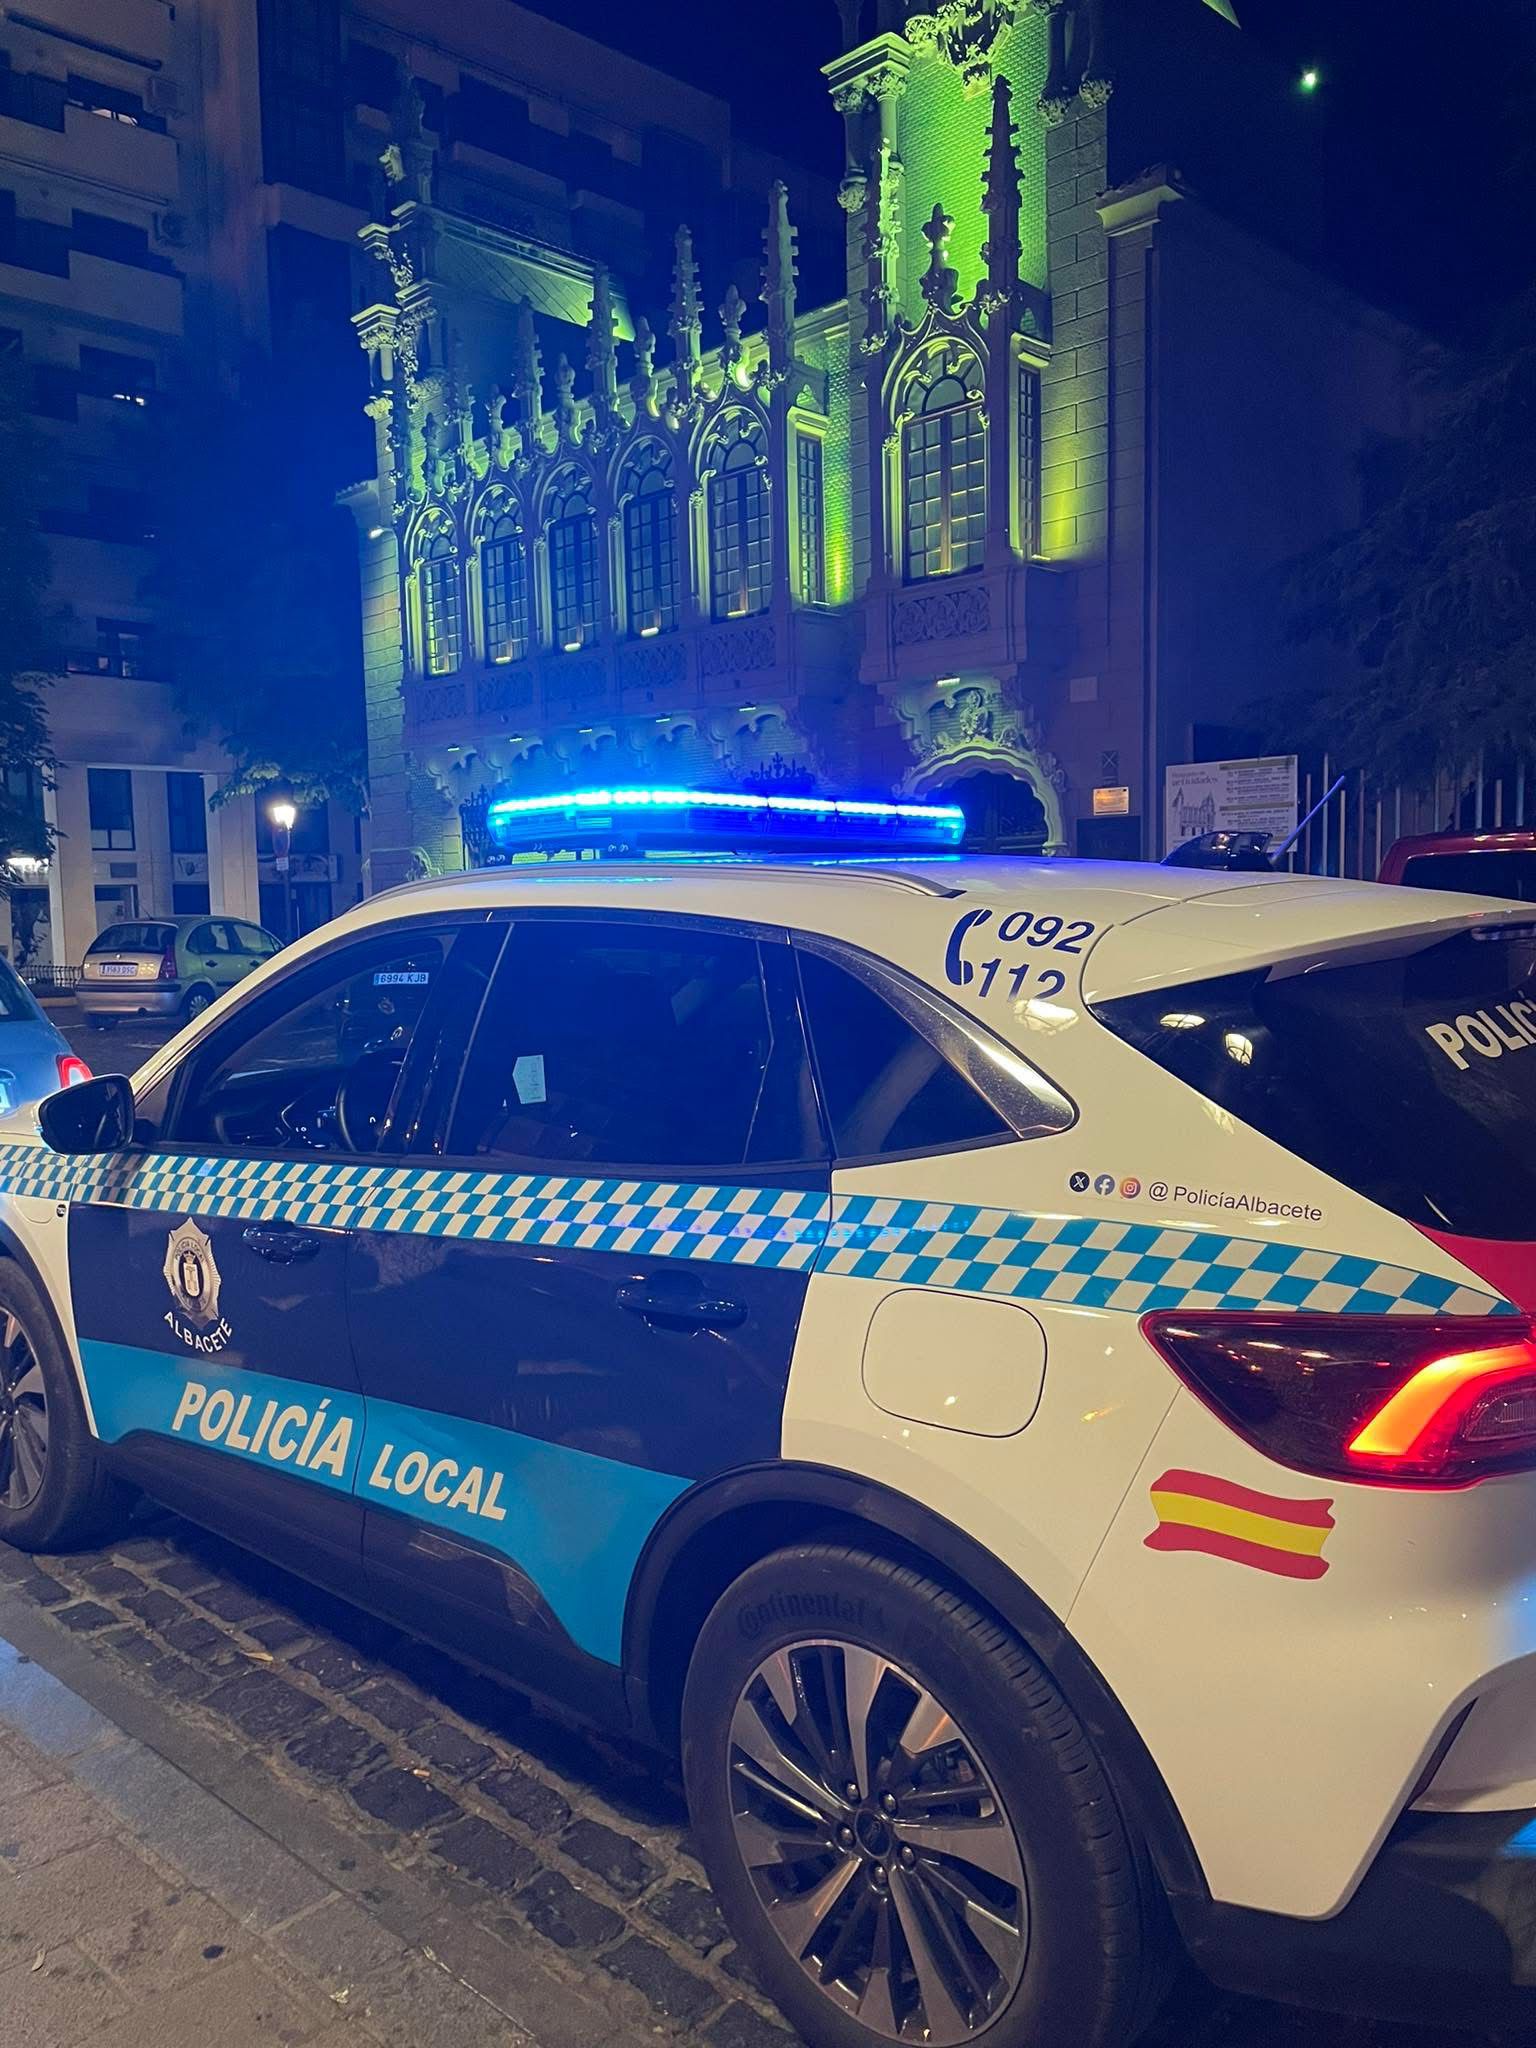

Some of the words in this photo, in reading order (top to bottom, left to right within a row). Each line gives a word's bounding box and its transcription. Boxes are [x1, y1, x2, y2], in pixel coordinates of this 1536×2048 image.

[998, 911, 1095, 954] 092
[380, 974, 404, 983] 6994
[406, 973, 427, 983] KJB
[979, 958, 1066, 1002] 112
[1149, 1181, 1169, 1202] @
[1174, 1186, 1323, 1222] PolicíaAlbacete
[164, 1311, 233, 1353] ALBACETE
[171, 1382, 354, 1477] POLICÍA
[369, 1444, 508, 1521] LOCAL
